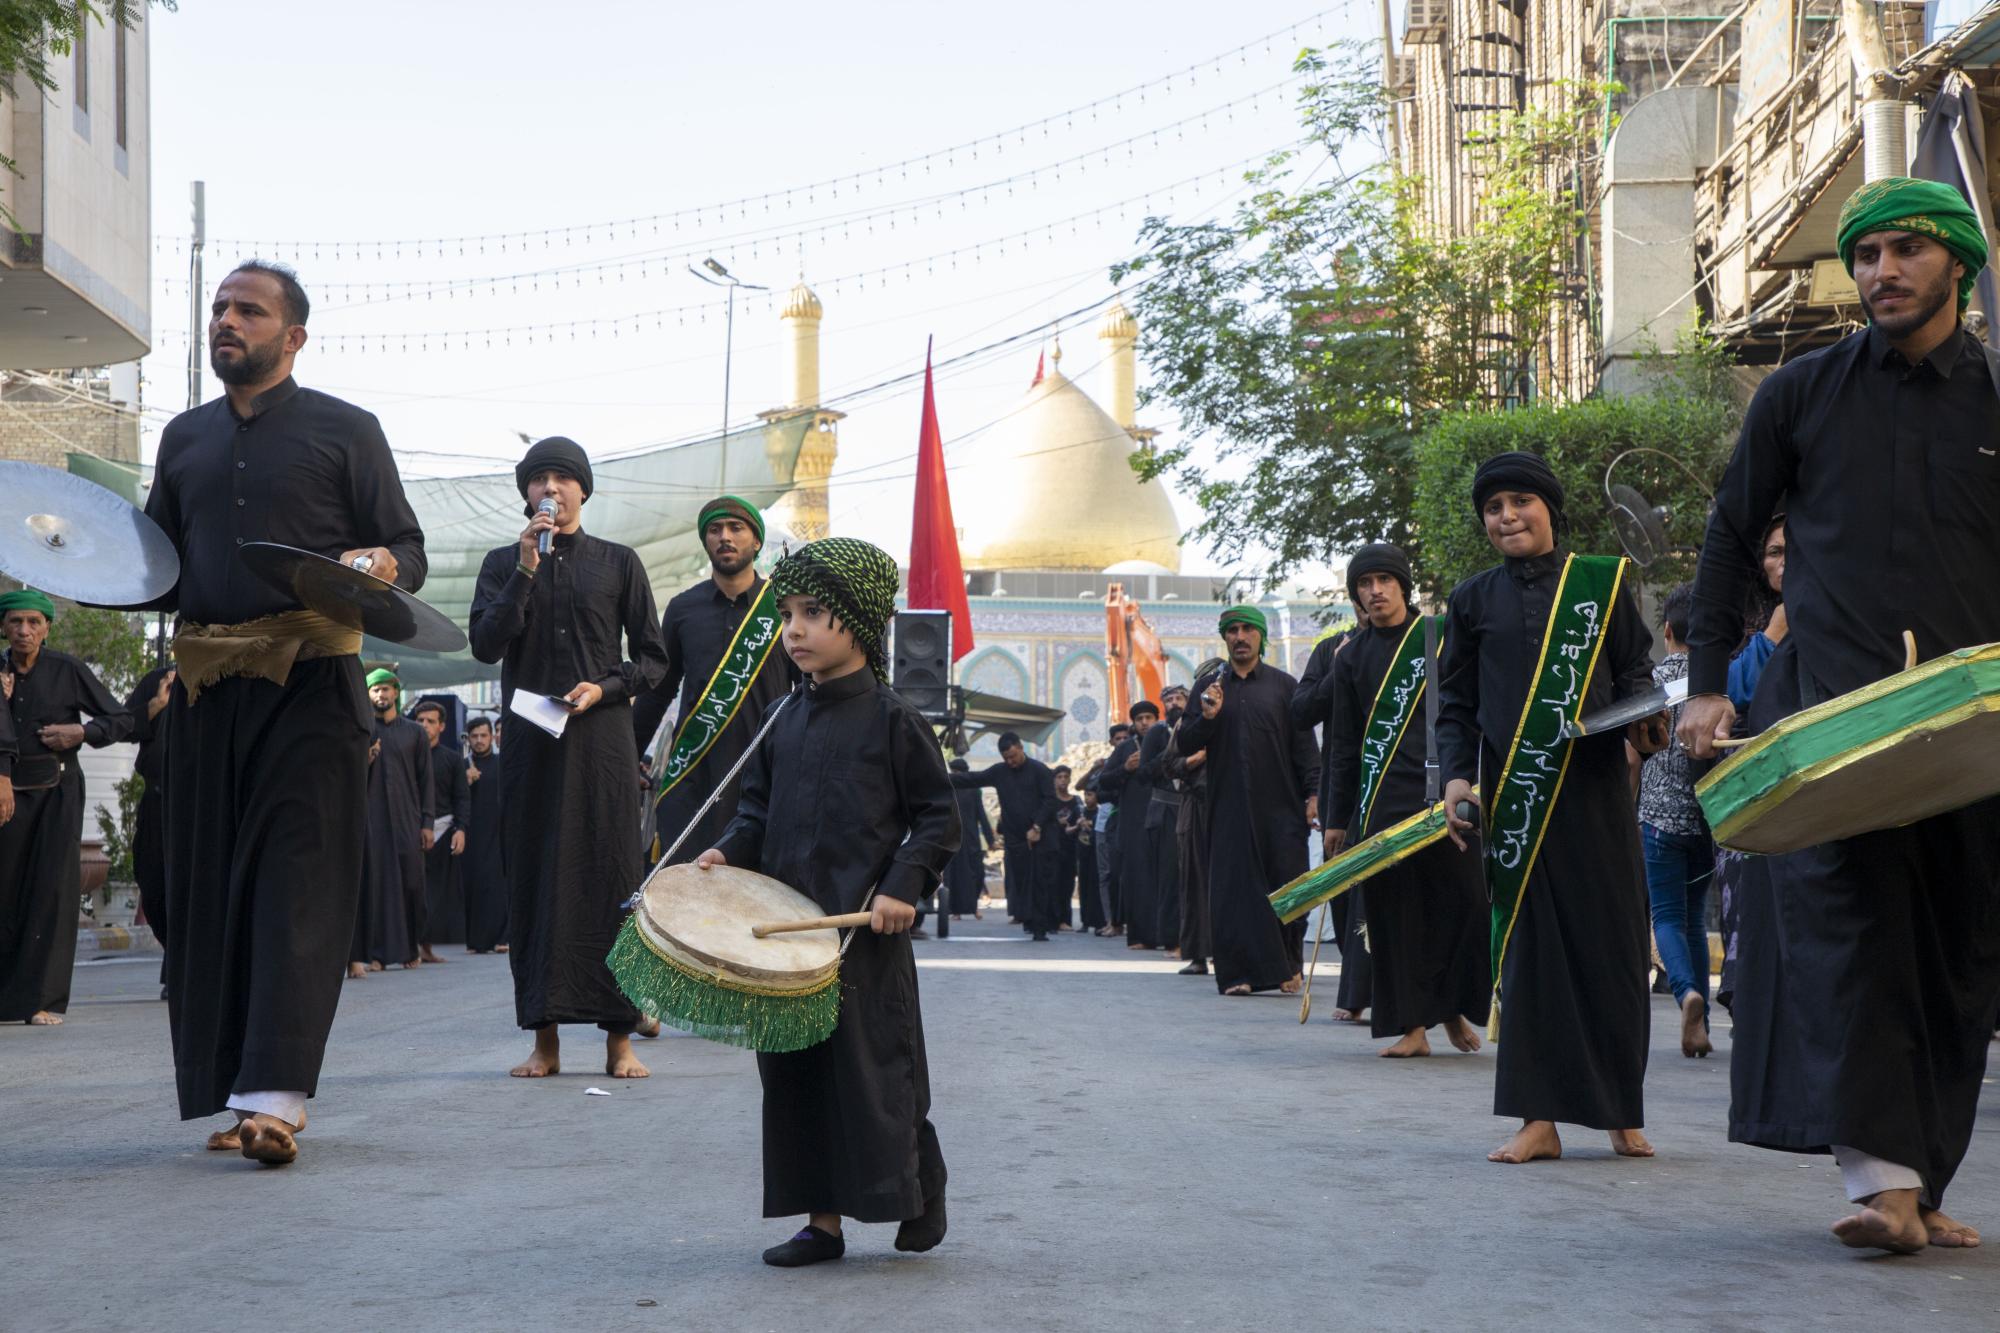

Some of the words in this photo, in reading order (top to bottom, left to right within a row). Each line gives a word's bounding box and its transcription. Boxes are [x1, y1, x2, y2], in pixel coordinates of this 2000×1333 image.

[744, 616, 774, 651] هيئة
[1559, 600, 1599, 661] هيئة
[723, 652, 754, 702] شباب
[1395, 657, 1426, 692] هيئة
[708, 693, 728, 719] أم
[1377, 690, 1407, 741] شباب
[1540, 663, 1583, 747] شباب
[667, 712, 717, 778] البنين
[1520, 739, 1561, 773] أم
[1490, 771, 1546, 870] البنين
